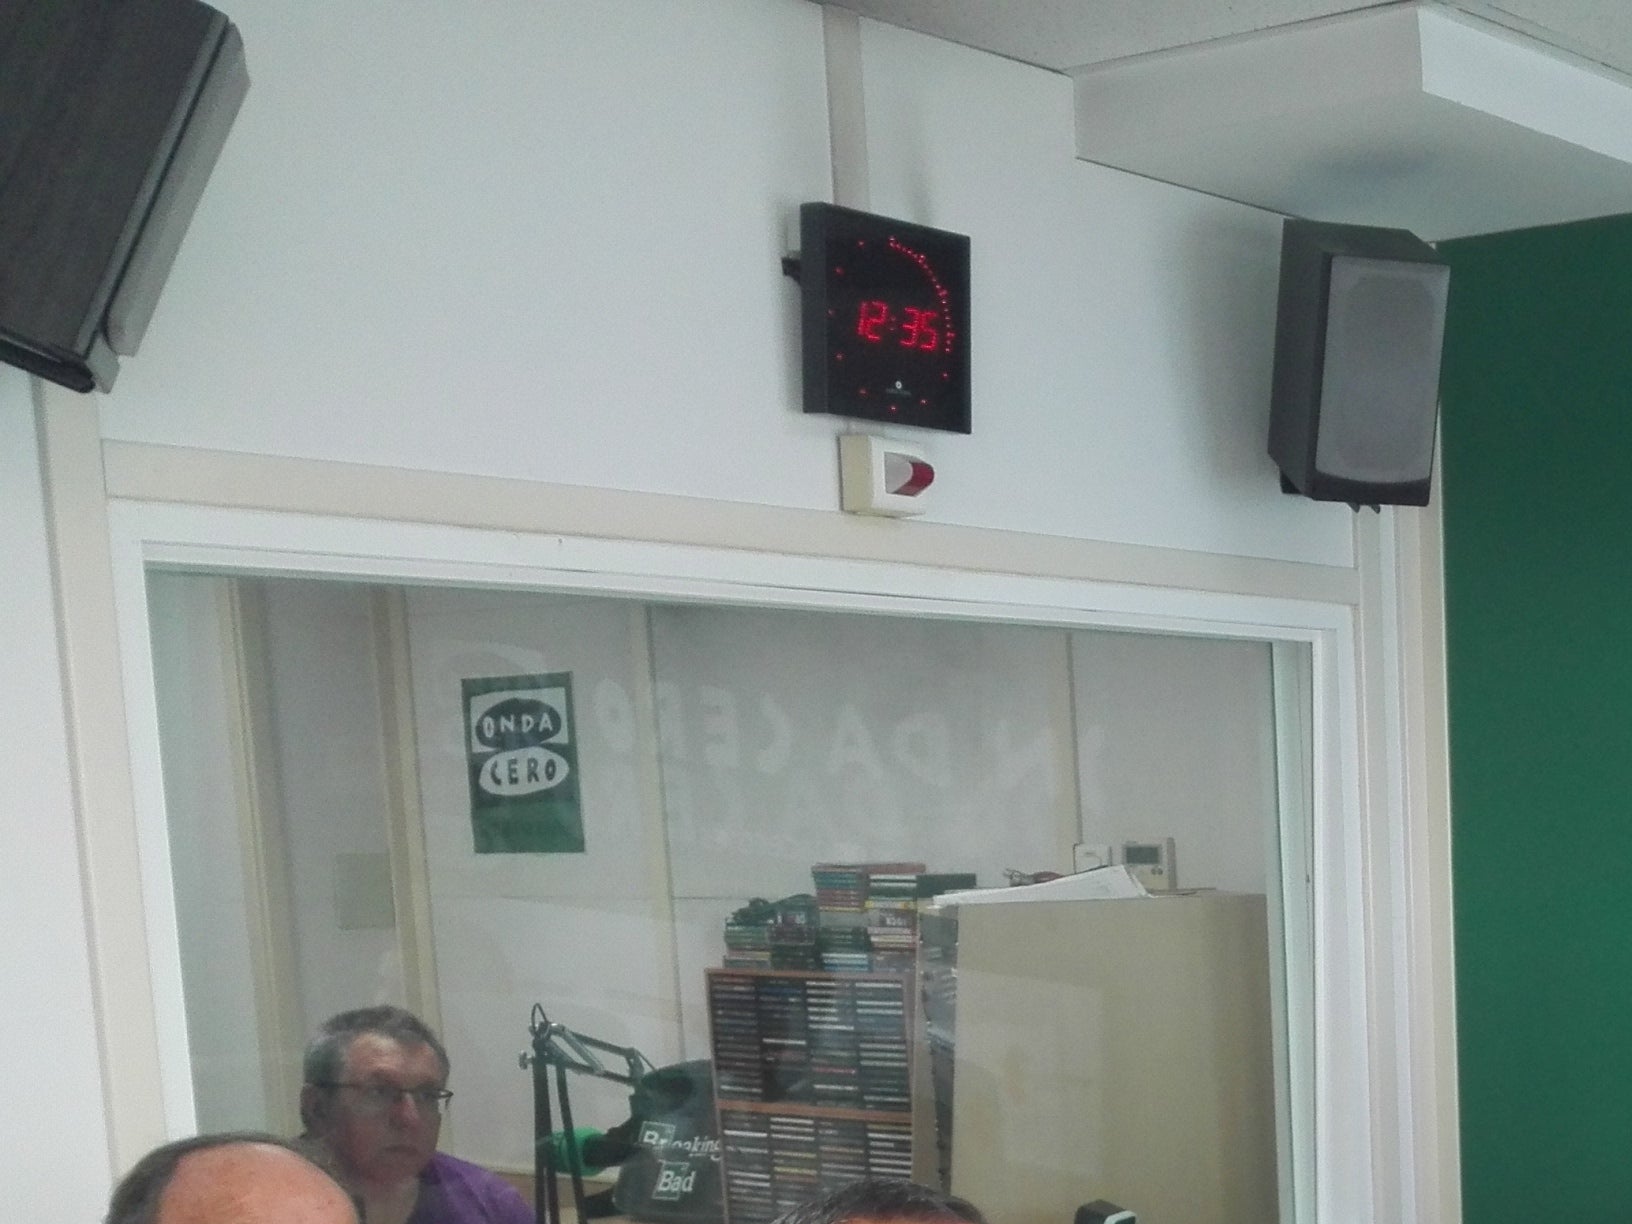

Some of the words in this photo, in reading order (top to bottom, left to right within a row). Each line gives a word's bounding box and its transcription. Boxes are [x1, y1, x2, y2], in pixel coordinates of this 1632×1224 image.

[858, 300, 938, 351] 12:35
[482, 713, 553, 738] ONDA
[491, 757, 557, 786] CERO
[658, 1171, 697, 1192] Bad
